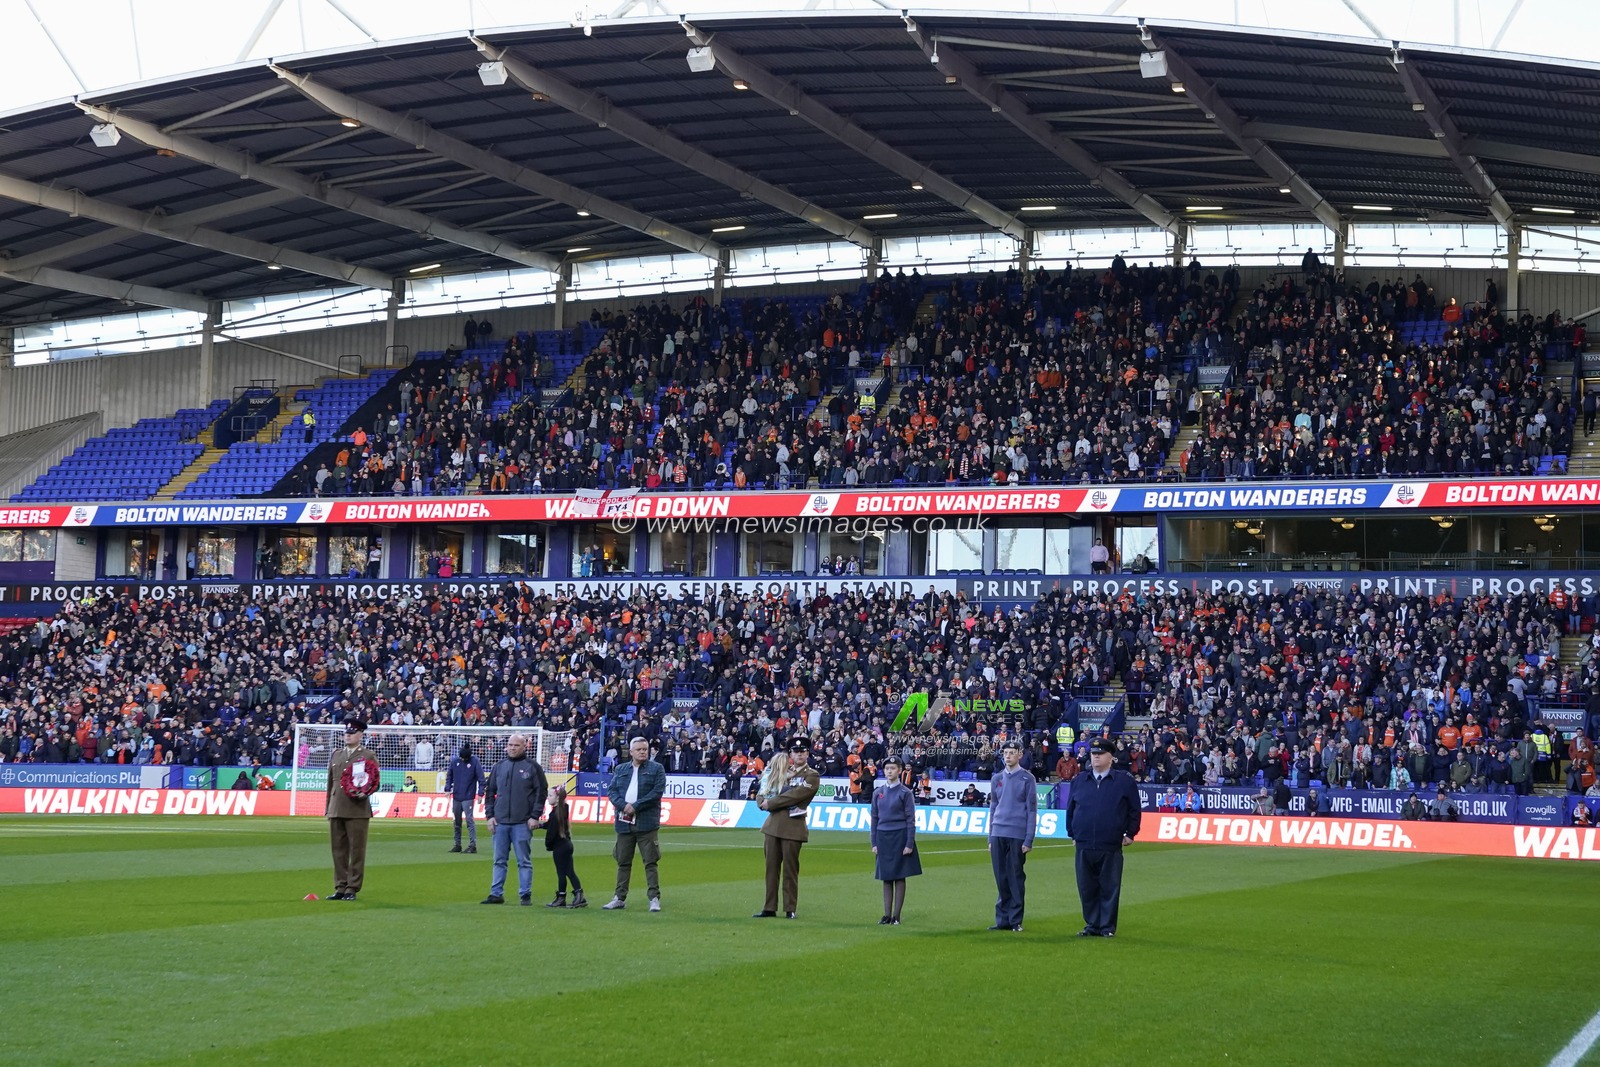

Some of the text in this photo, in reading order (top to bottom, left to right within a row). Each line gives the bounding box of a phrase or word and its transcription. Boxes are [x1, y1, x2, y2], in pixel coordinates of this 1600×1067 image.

[1143, 487, 1367, 508] BOLTON WANDERERS
[1446, 485, 1535, 502] BOLTON
[607, 504, 628, 512] FY4
[655, 497, 730, 516] DOWN
[855, 493, 1060, 512] BOLTON WANDERERS
[115, 505, 287, 523] BOLTON WANDERERS
[345, 504, 415, 519] BOLTON
[138, 586, 188, 600] POST
[202, 586, 239, 594] FRANKING
[555, 582, 668, 598] FRANKING
[973, 580, 1042, 597] PRINT
[1073, 580, 1179, 596] PROCESS
[1211, 579, 1274, 596] POST
[1360, 578, 1437, 596] PRINT
[1472, 577, 1593, 596] PROCESS
[18, 770, 117, 784] Communications
[24, 788, 259, 815] WALKING DOWN
[1361, 797, 1393, 813] EMAIL
[1525, 805, 1557, 816] cowgills
[1158, 816, 1274, 844] BOLTON
